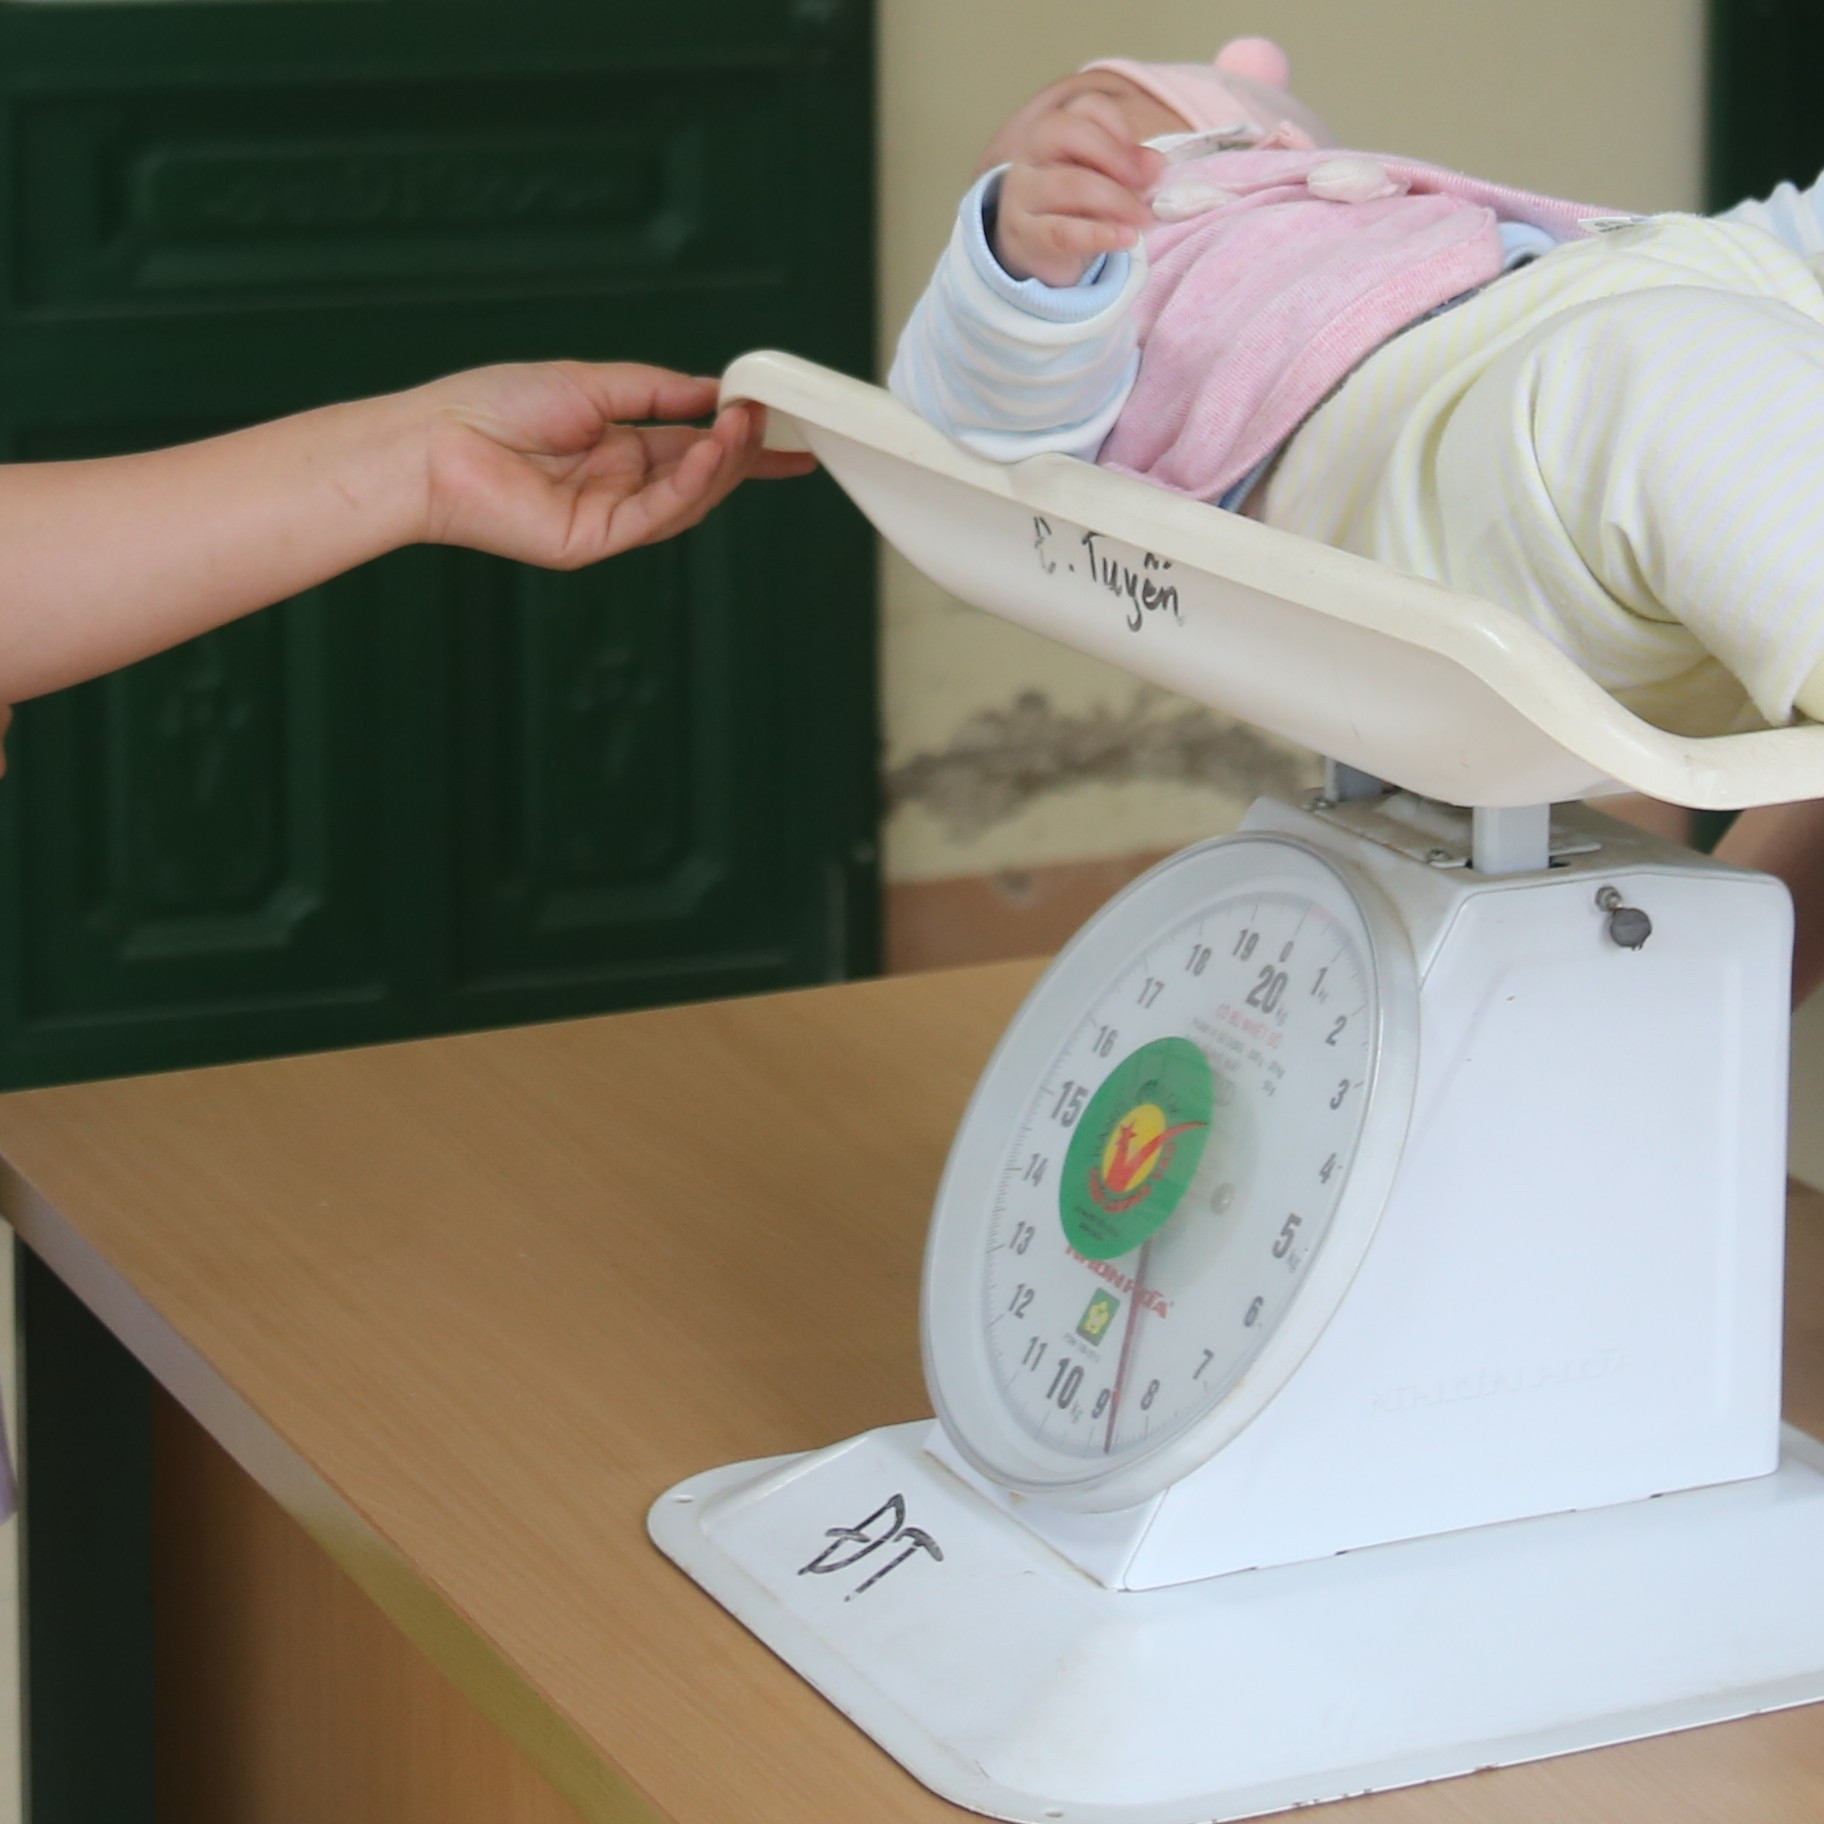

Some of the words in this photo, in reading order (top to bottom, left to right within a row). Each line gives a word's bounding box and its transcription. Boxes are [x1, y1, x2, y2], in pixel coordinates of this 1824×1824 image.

[1184, 943, 1212, 976] 18
[1232, 928, 1260, 961] 19
[1137, 977, 1165, 1009] 17
[1245, 964, 1289, 1014] 20
[1310, 966, 1328, 996] 1
[1092, 1024, 1119, 1058] 16
[1325, 1014, 1347, 1046] 2
[1051, 1079, 1089, 1128] 15
[1330, 1078, 1350, 1110] 3
[1023, 1152, 1049, 1187] 14
[1319, 1152, 1337, 1184] 4
[1008, 1220, 1036, 1255] 13
[1271, 1211, 1303, 1259] 5
[1007, 1283, 1035, 1319] 12
[1242, 1295, 1264, 1328] 6
[1022, 1336, 1048, 1371] 11
[1192, 1348, 1214, 1380] 7
[1046, 1357, 1085, 1410] 10
[1140, 1378, 1160, 1411] 8
[1091, 1387, 1111, 1419] 9
